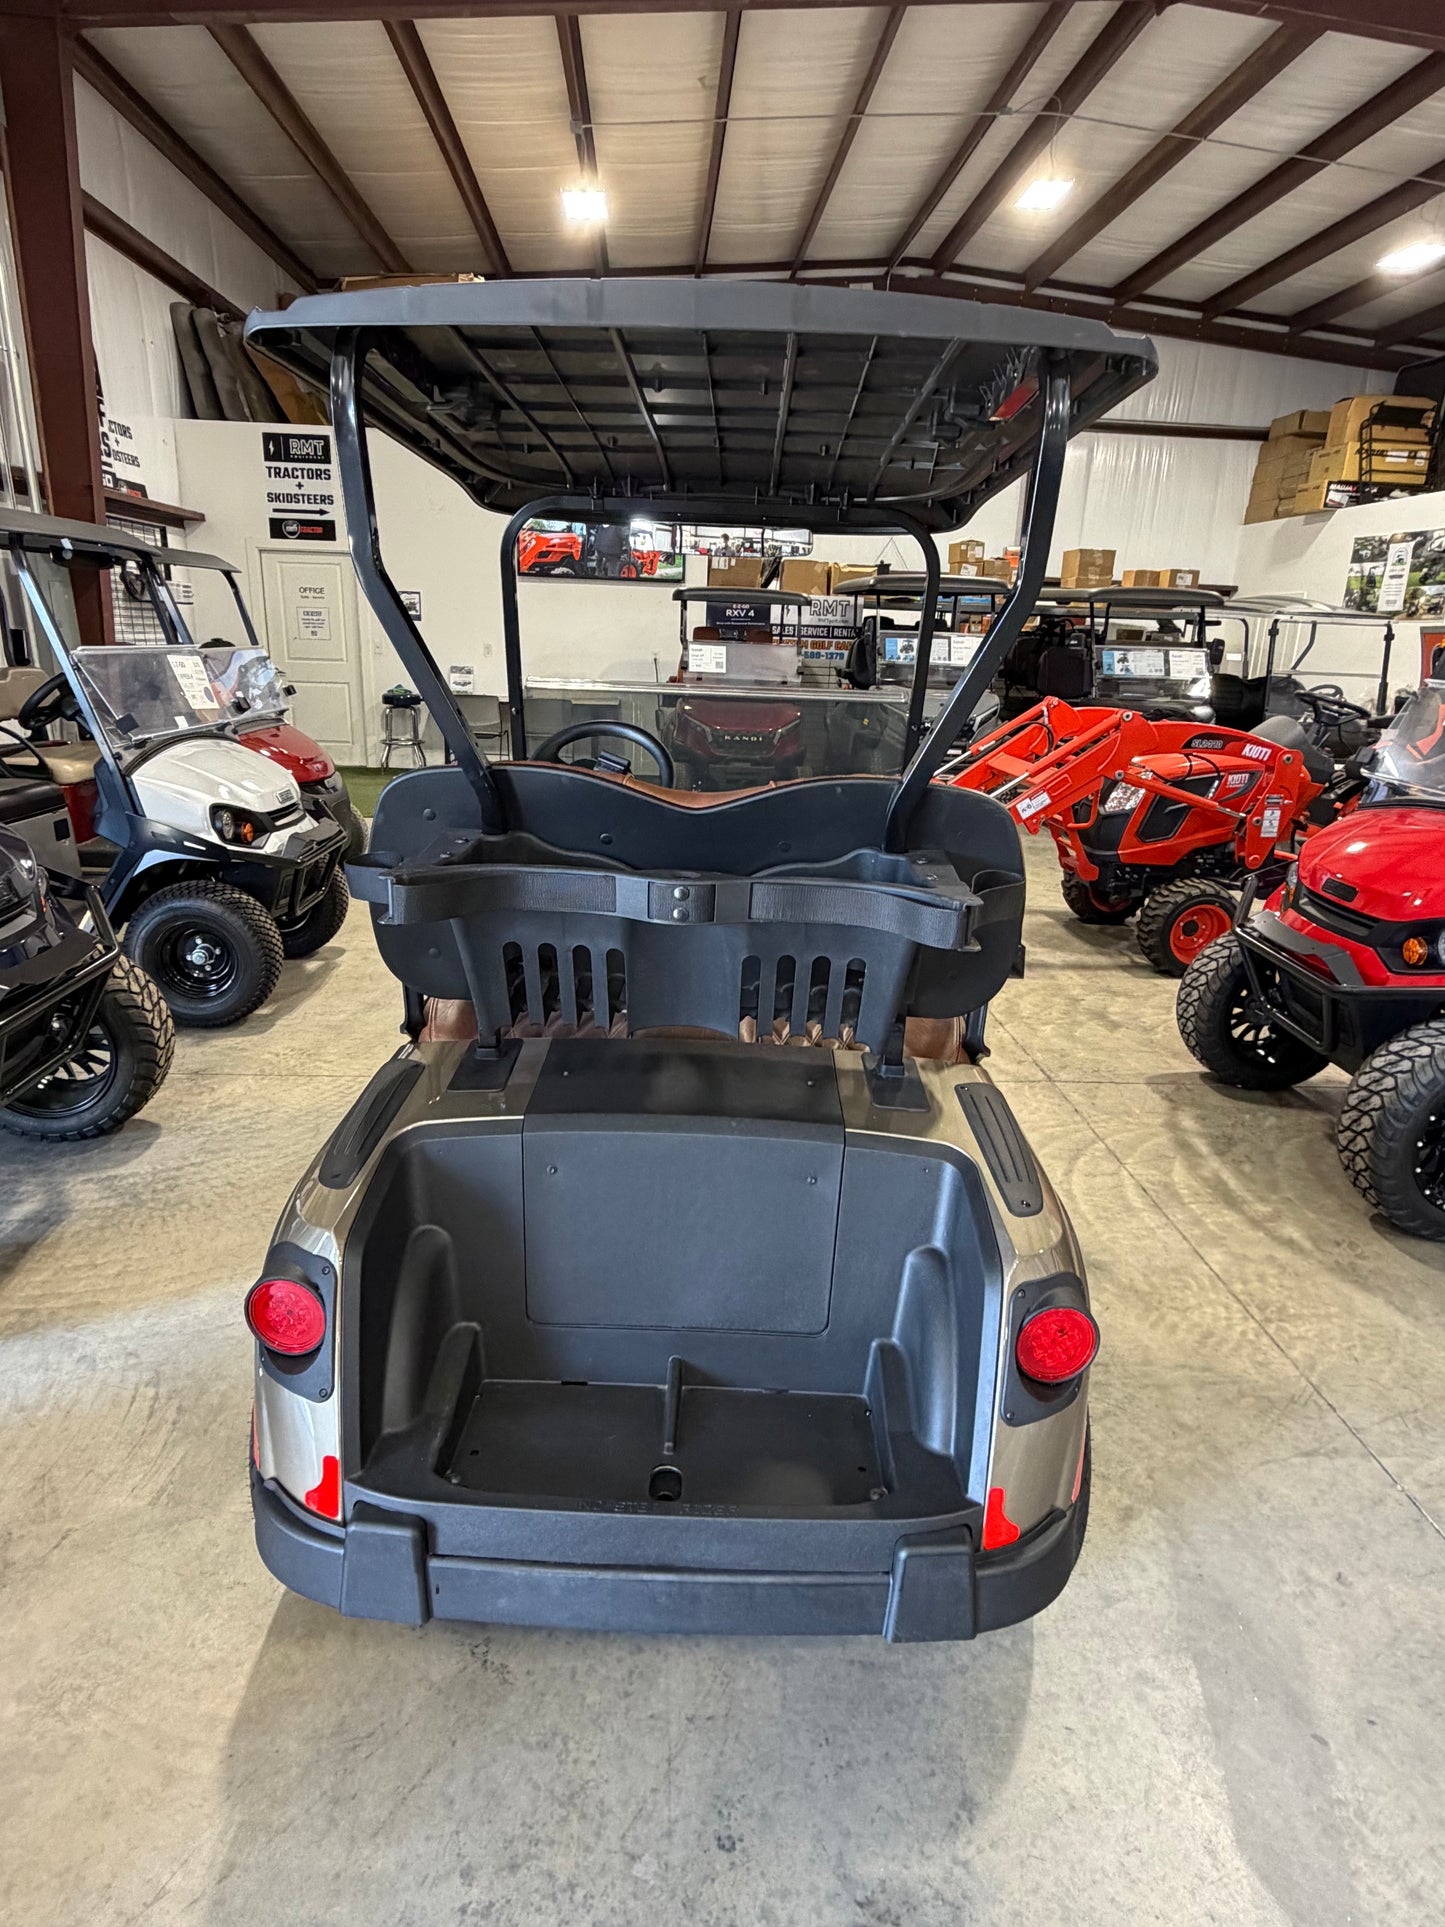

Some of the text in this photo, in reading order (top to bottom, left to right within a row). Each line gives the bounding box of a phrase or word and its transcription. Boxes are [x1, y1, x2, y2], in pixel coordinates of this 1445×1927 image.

[289, 438, 325, 455] RMT
[265, 466, 332, 480] TRACTORS
[266, 492, 335, 506] SKIDSTEERS
[298, 586, 325, 594] OFFICE
[725, 609, 755, 617] RXV 4
[809, 599, 850, 617] RMT
[800, 626, 829, 637] SERVICE
[833, 627, 857, 638] RENTA
[810, 640, 833, 651] GOLF
[1241, 743, 1272, 762] KIOTI
[1227, 773, 1250, 785] KIOTI
